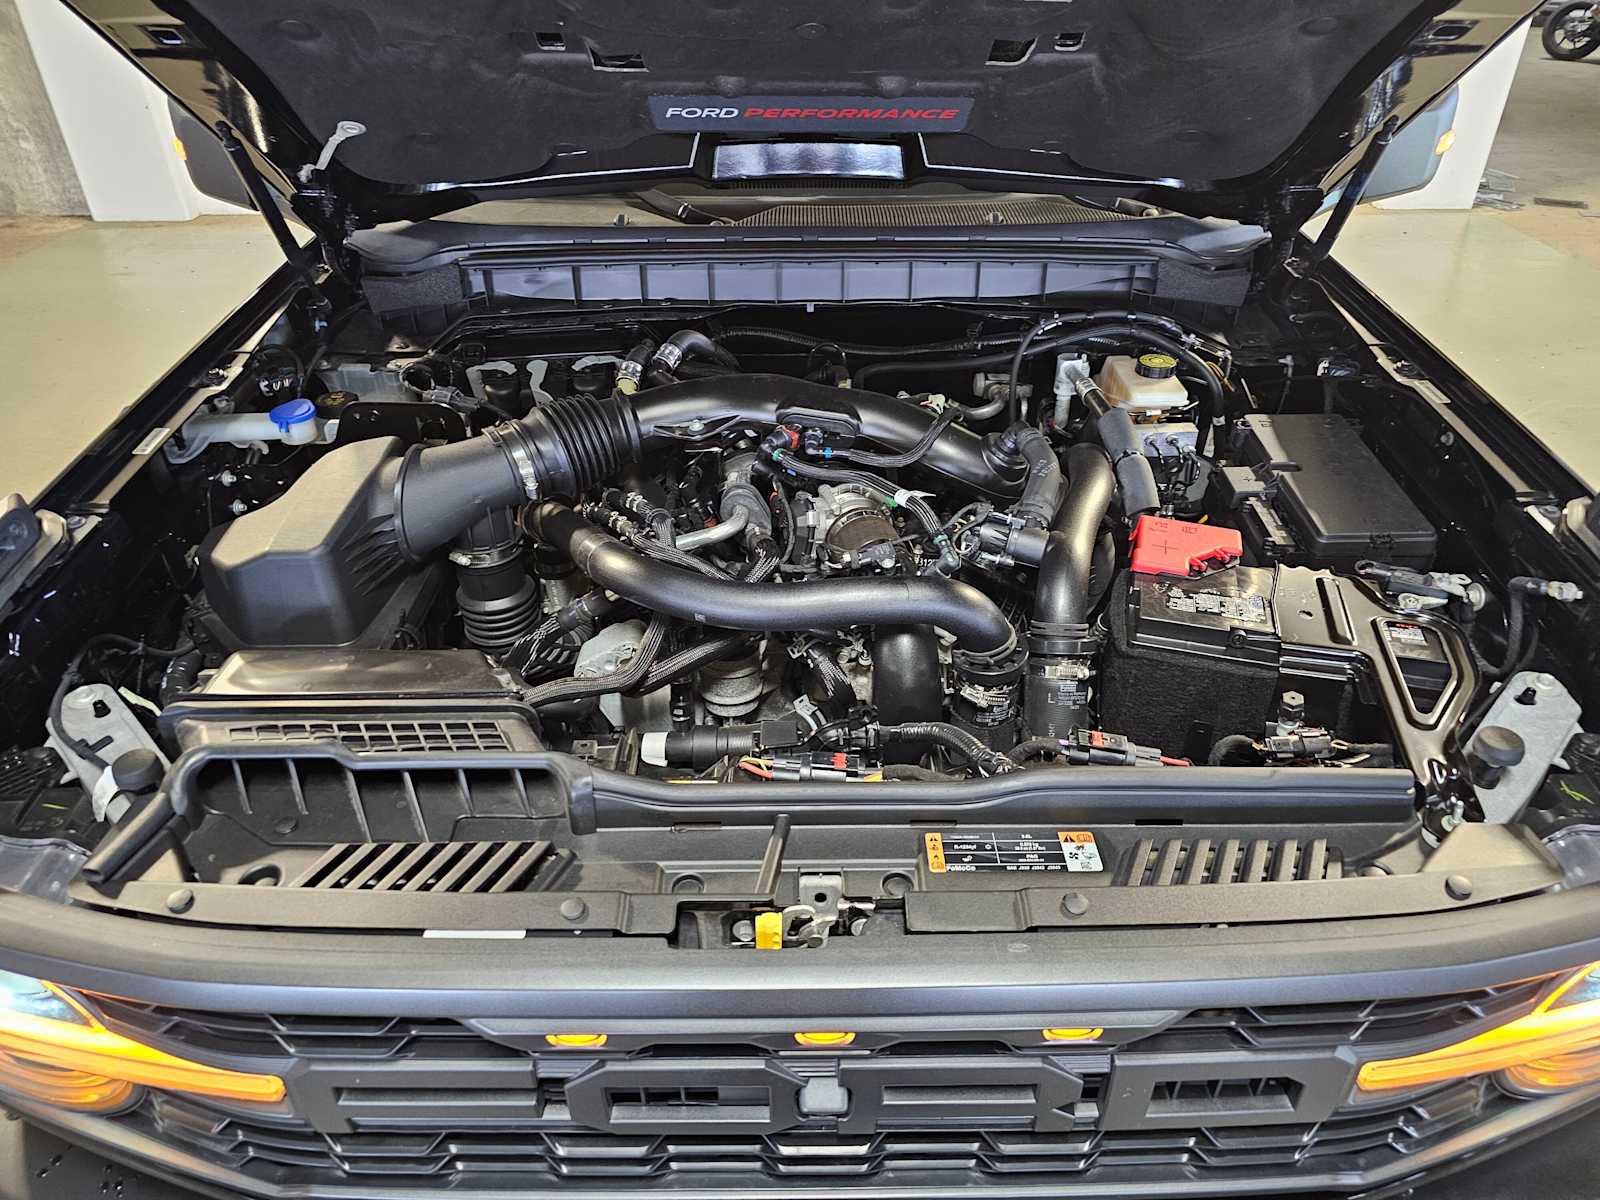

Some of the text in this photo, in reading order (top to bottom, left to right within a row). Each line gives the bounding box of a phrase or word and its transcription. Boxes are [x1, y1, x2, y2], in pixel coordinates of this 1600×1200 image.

[665, 107, 961, 120] FORD PERFORMANCE
[290, 1048, 1356, 1136] FORD
